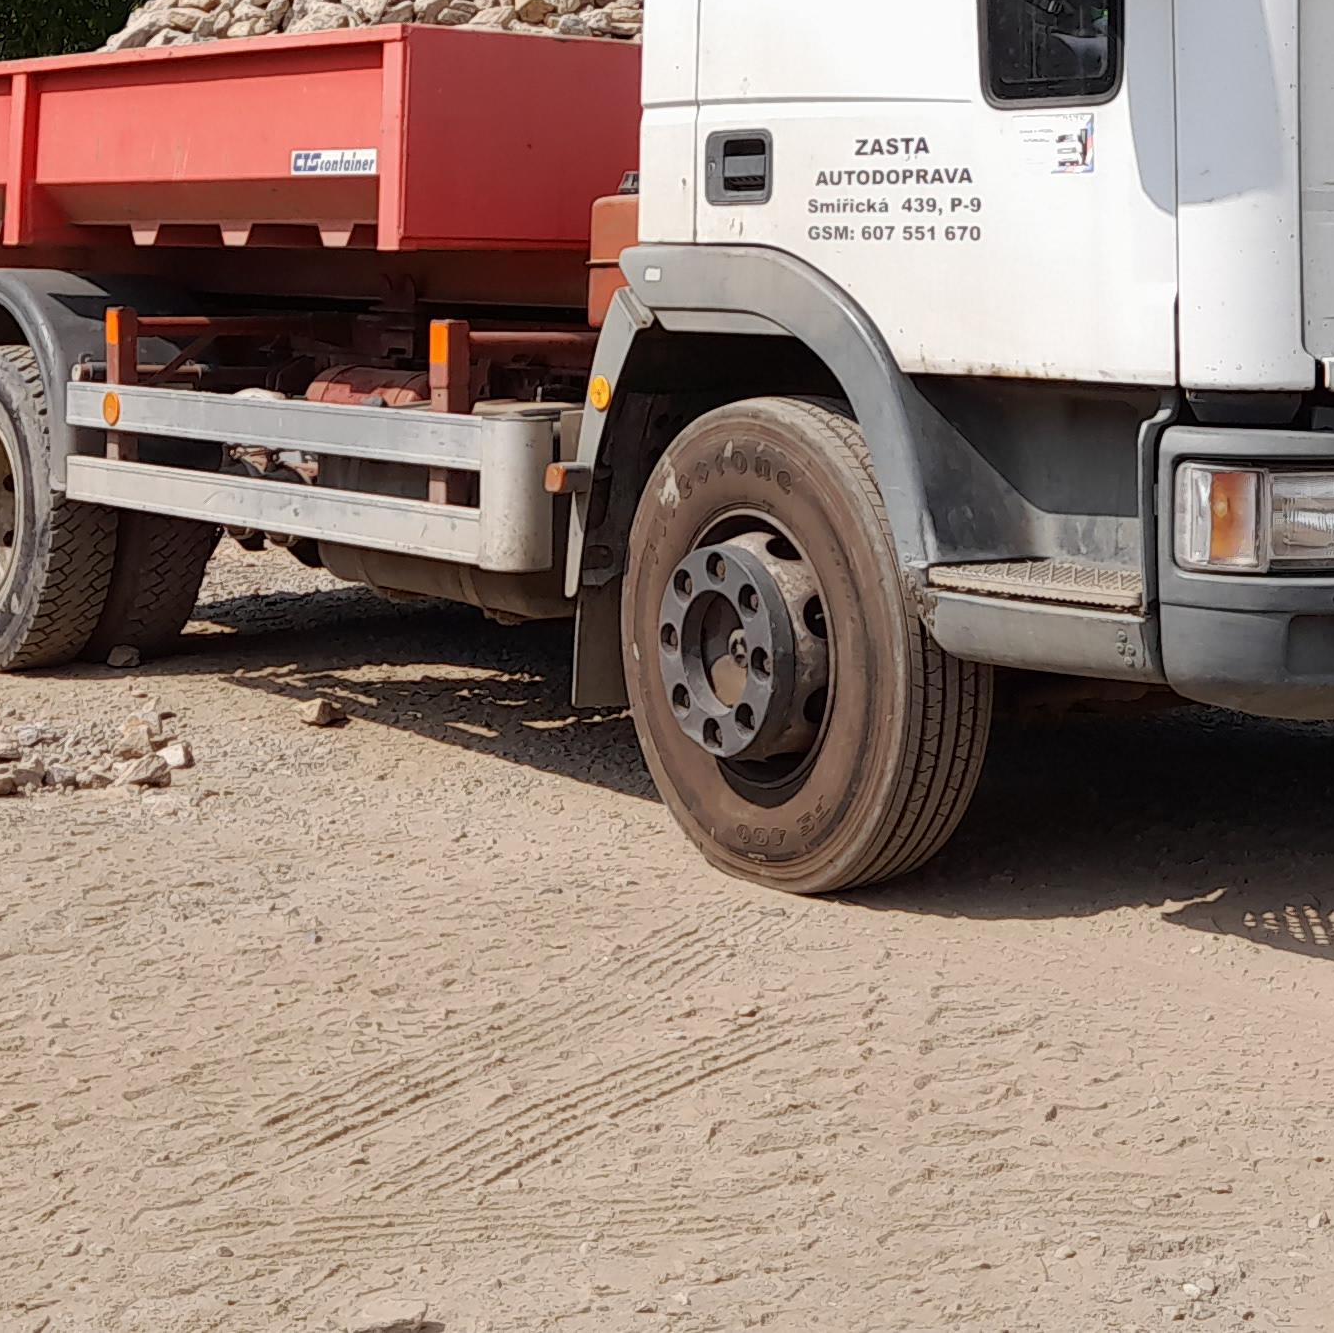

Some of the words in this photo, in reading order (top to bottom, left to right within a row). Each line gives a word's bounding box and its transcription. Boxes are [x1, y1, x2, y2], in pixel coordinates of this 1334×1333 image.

[854, 137, 930, 157] ZASTA
[319, 151, 376, 172] container
[815, 167, 973, 187] AUTODOPRAVA
[807, 196, 889, 215] Smiřická
[900, 197, 944, 216] 439,
[949, 197, 983, 214] P-9
[807, 225, 856, 242] GSM:
[860, 224, 896, 242] 607
[902, 224, 937, 242] 551
[944, 224, 983, 242] 670
